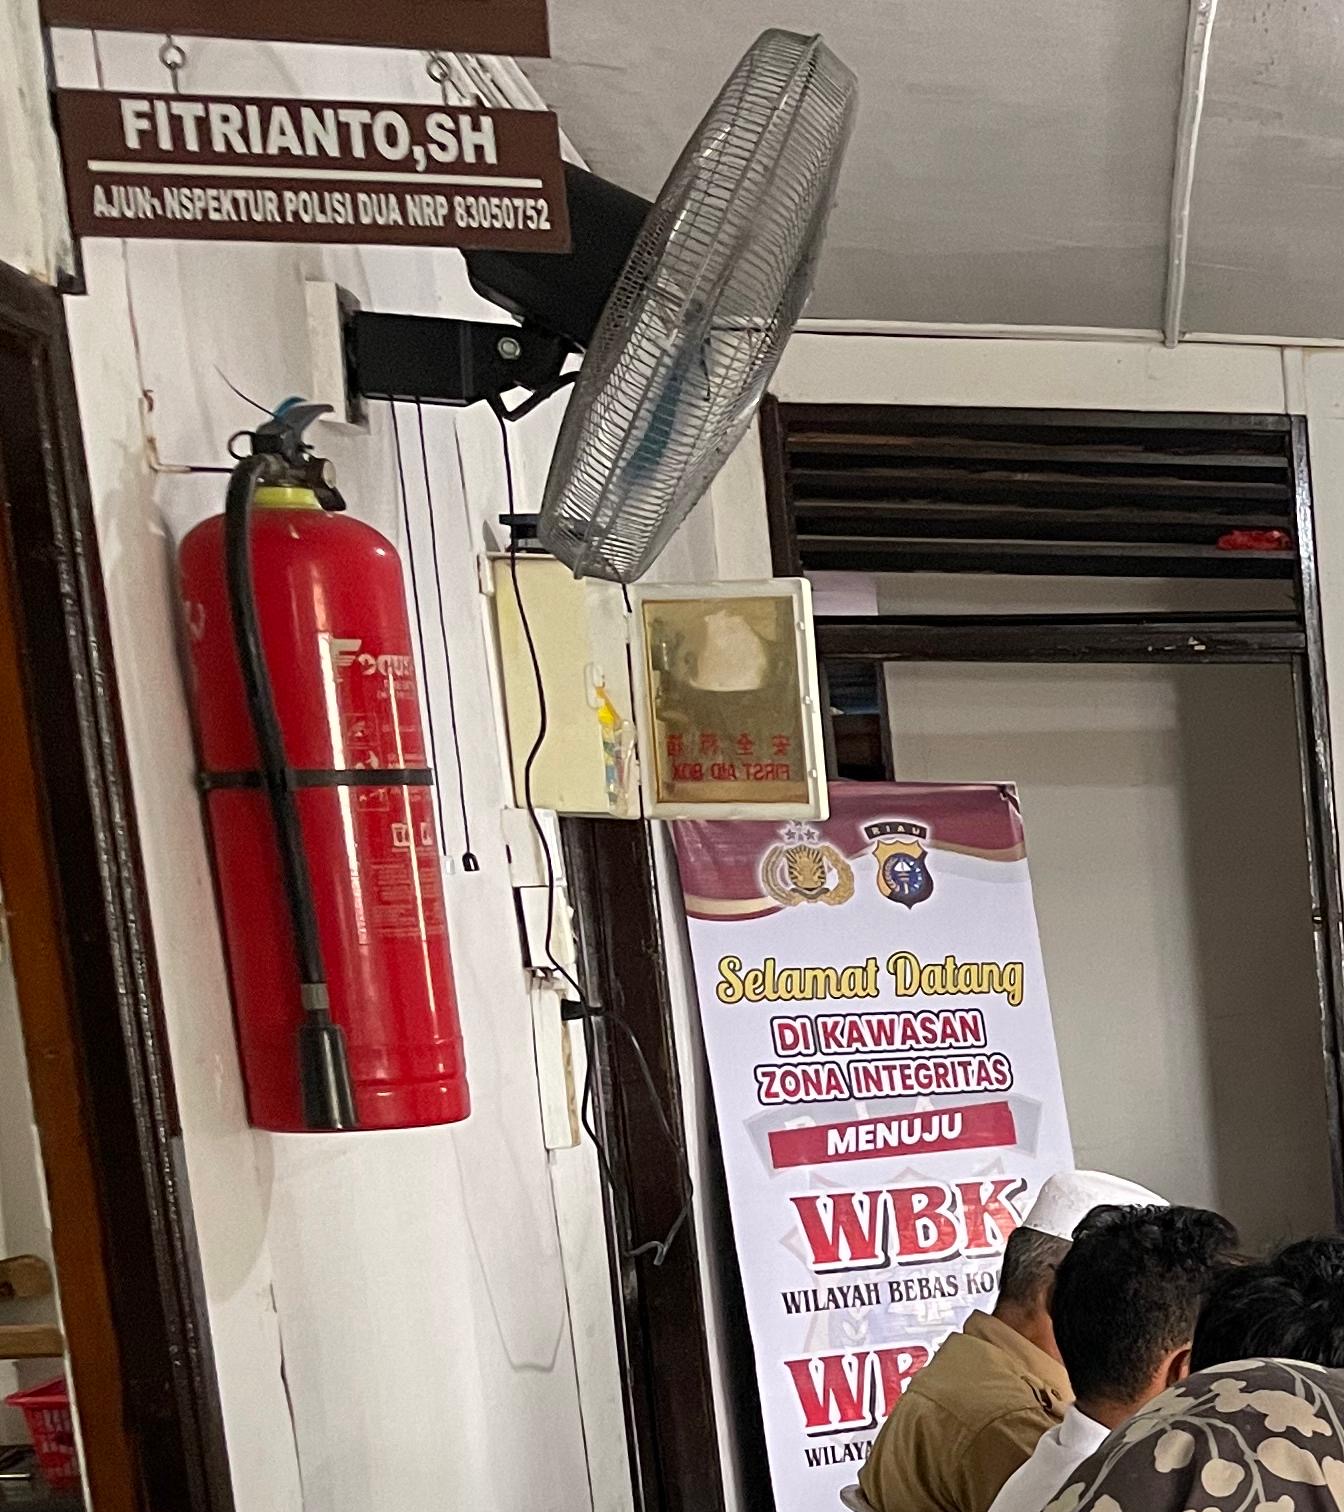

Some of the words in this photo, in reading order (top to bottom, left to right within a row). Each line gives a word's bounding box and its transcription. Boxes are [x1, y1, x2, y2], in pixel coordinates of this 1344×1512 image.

[119, 98, 499, 173] FITRIANTO,SH
[283, 190, 354, 225] POLISI
[359, 194, 404, 226] DUA
[407, 195, 446, 228] NRP
[454, 198, 551, 231] 83050752
[870, 823, 921, 838] RIAU
[716, 955, 879, 1004] Selamat
[887, 951, 1025, 1008] Datang
[775, 1019, 815, 1054] DI
[821, 1013, 984, 1051] KAWASAN
[760, 1067, 845, 1101] ZONA
[854, 1058, 1009, 1096] INTEGRITAS
[826, 1113, 963, 1156] MENUJU
[788, 1178, 1020, 1268] WBK
[781, 1282, 880, 1315] WILAYAH
[887, 1274, 960, 1303] BEBAS
[966, 1269, 1001, 1297] KO
